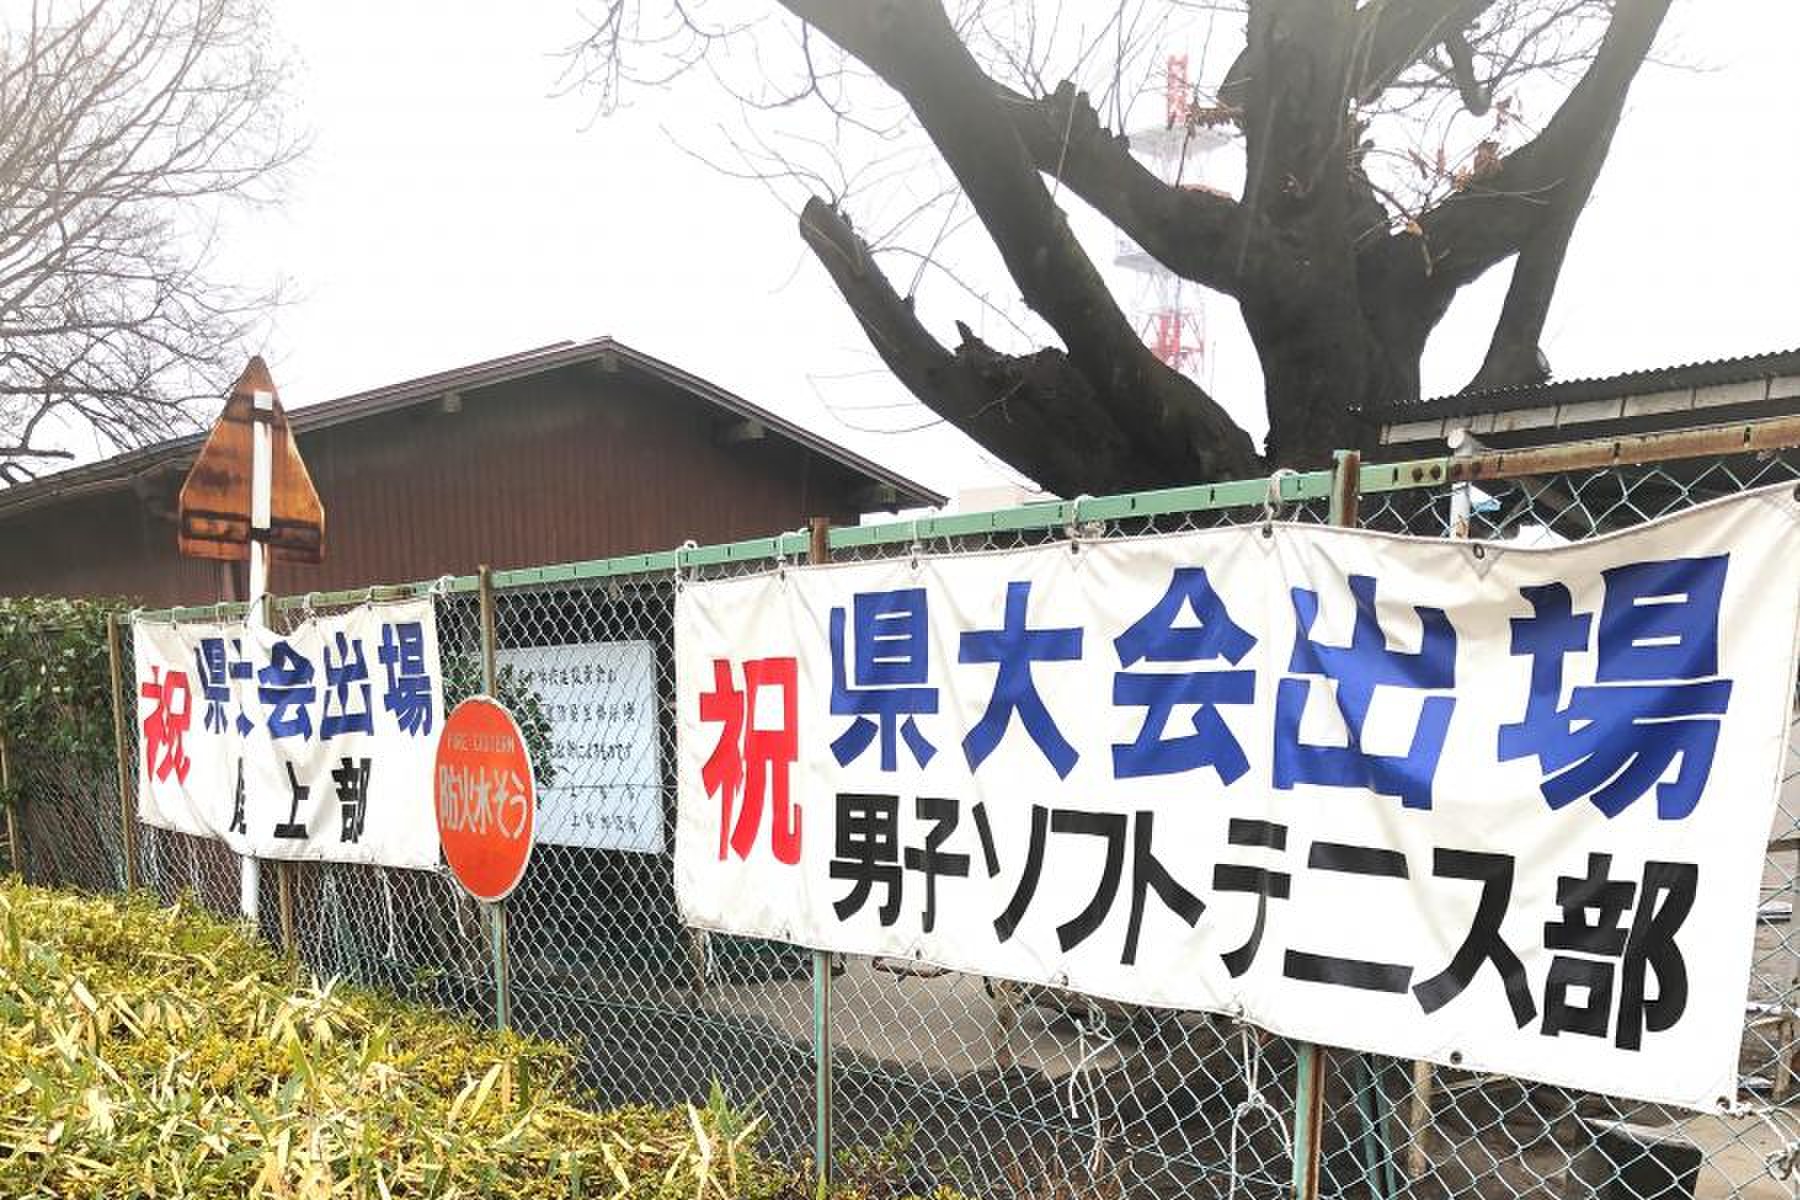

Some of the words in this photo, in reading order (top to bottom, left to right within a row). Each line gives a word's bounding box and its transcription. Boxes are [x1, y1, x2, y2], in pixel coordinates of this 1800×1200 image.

[142, 667, 192, 785] 祝
[699, 657, 802, 864] 祝
[829, 553, 1732, 820] 県大会出場
[438, 764, 528, 839] 防火水そう
[829, 794, 1698, 1051] 男子ソフトテニス部
